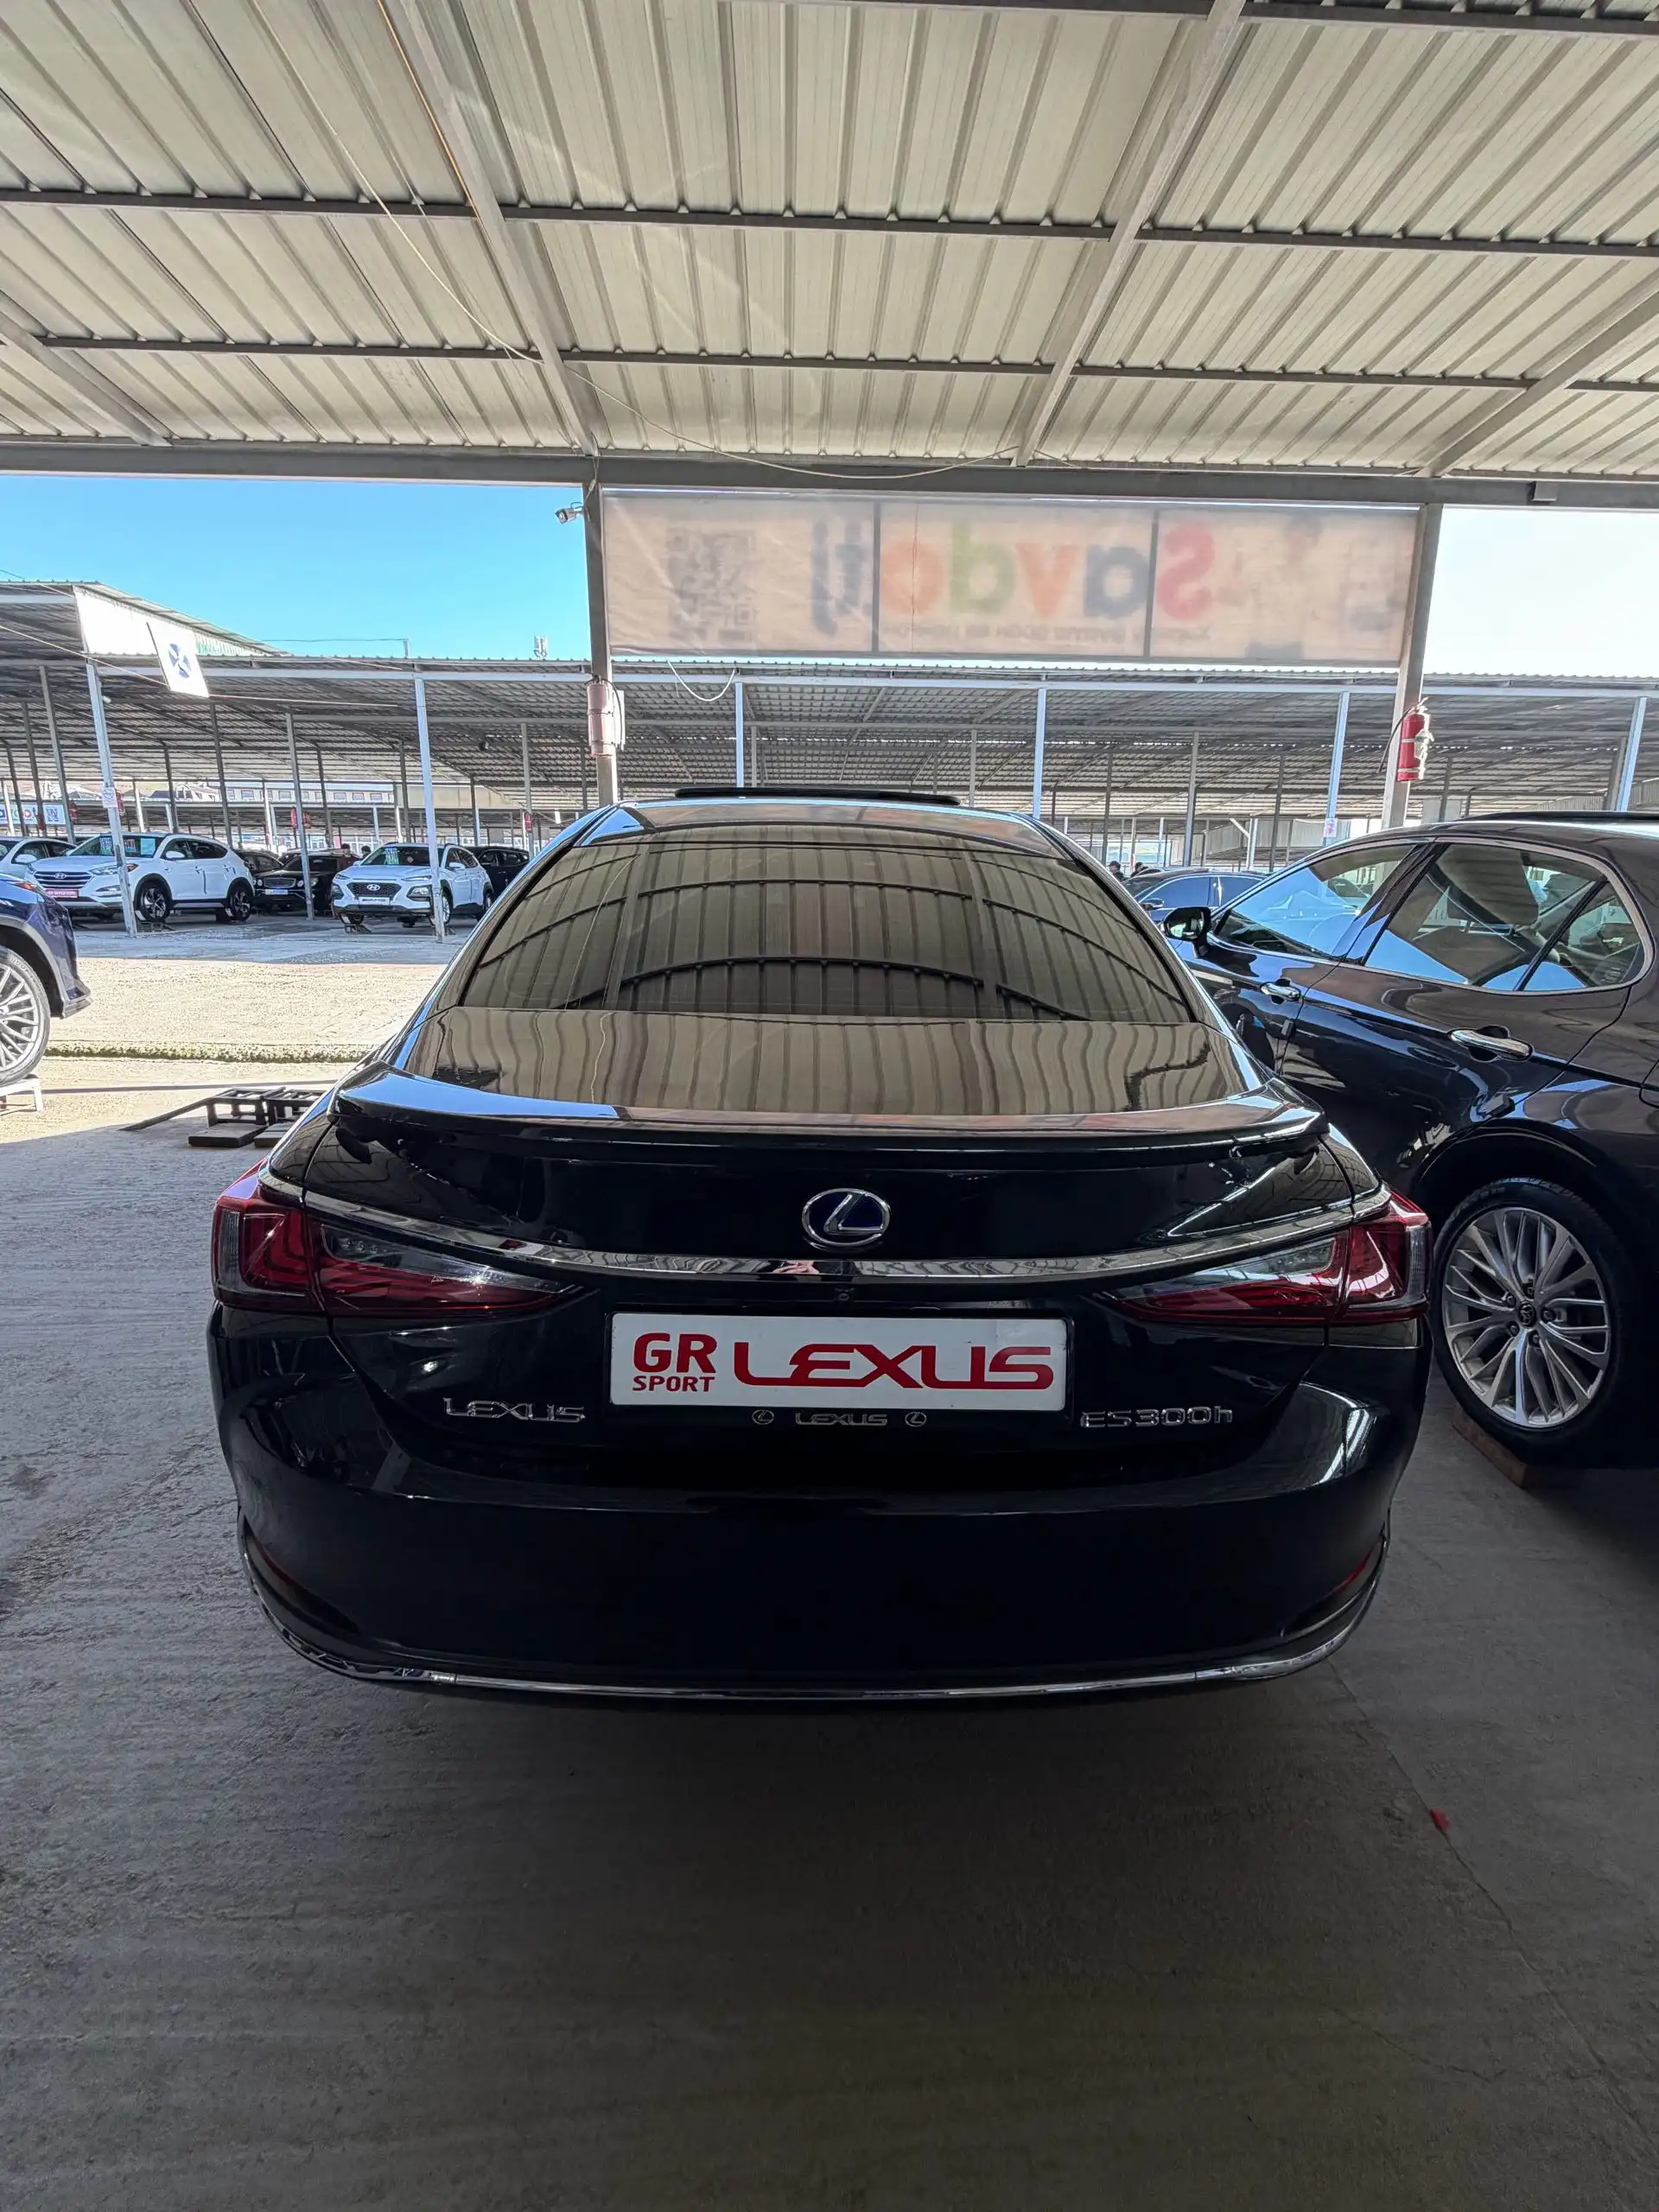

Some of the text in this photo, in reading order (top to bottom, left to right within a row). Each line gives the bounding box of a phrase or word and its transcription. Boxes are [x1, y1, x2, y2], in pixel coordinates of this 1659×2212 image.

[633, 1332, 718, 1374] GR
[734, 1341, 1054, 1390] LEXUS
[632, 1375, 716, 1393] SPORT
[442, 1396, 587, 1423] LEXUS
[794, 1411, 888, 1427] LEXUS
[1079, 1404, 1234, 1428] ES300h
